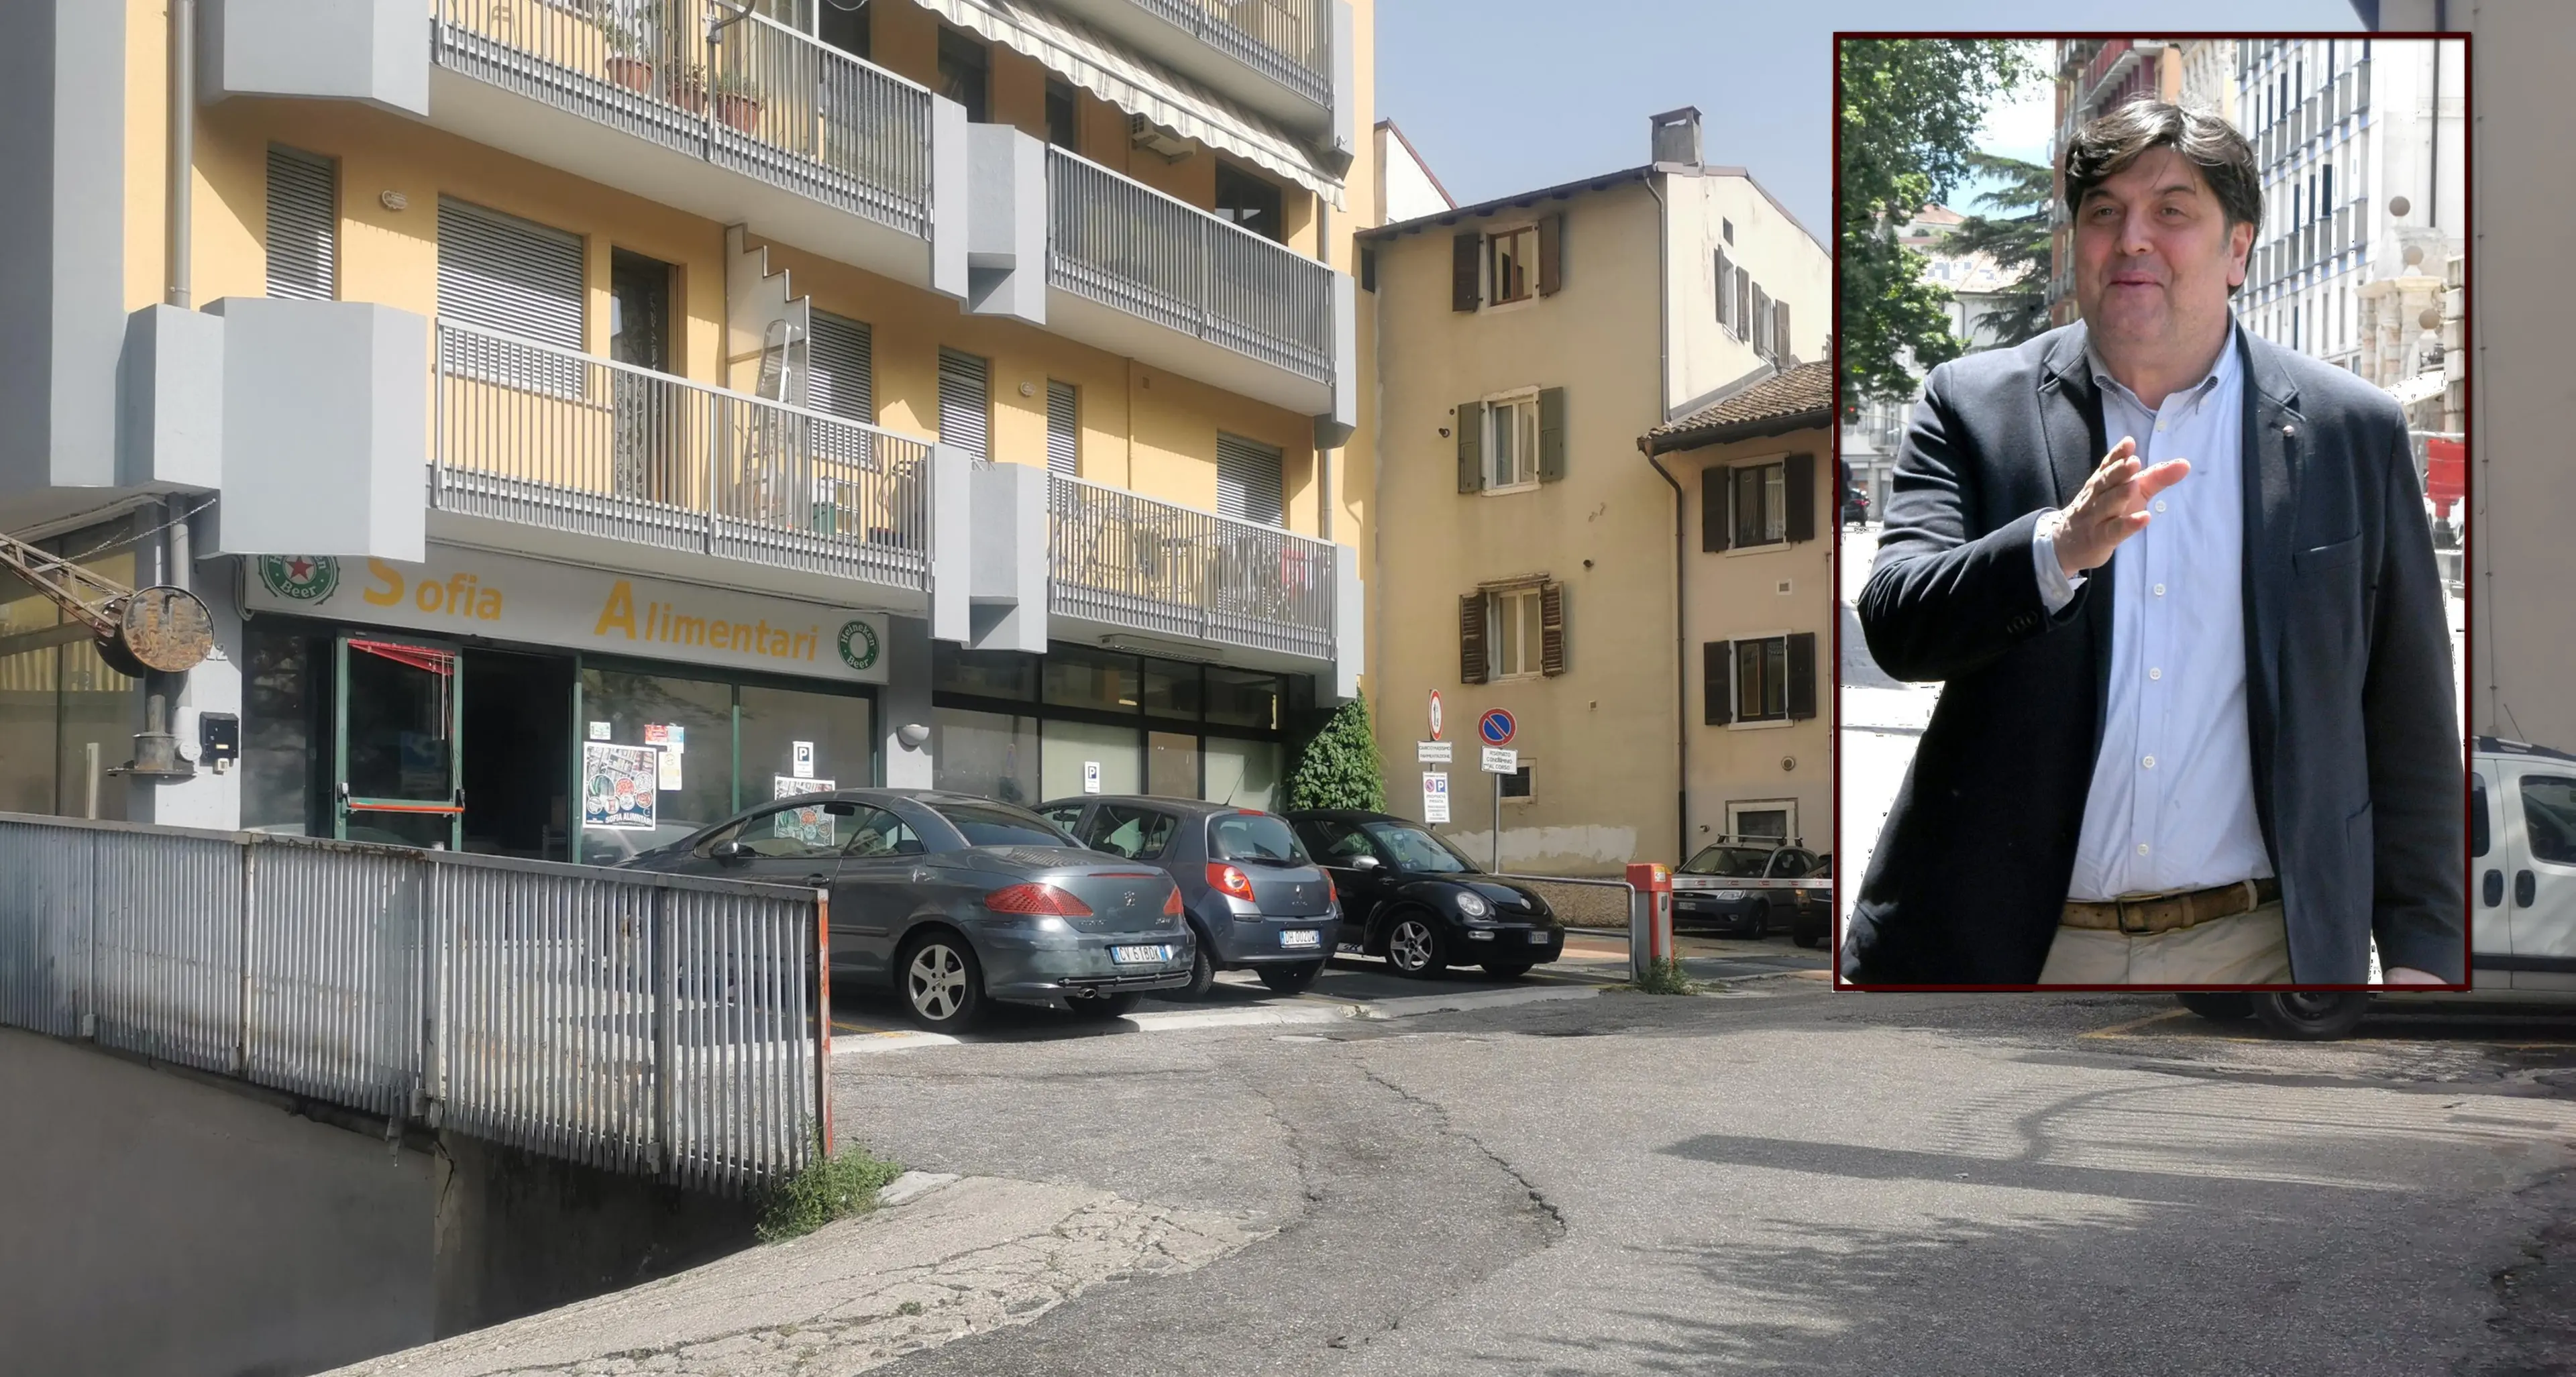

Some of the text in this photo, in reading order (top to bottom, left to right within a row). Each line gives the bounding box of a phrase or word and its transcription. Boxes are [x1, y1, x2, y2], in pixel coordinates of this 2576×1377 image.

[280, 580, 317, 598] Beer
[362, 556, 819, 661] Sofia Alimentari
[841, 624, 875, 646] Heineken
[847, 655, 869, 669] Beer
[605, 813, 623, 824] SOFIA
